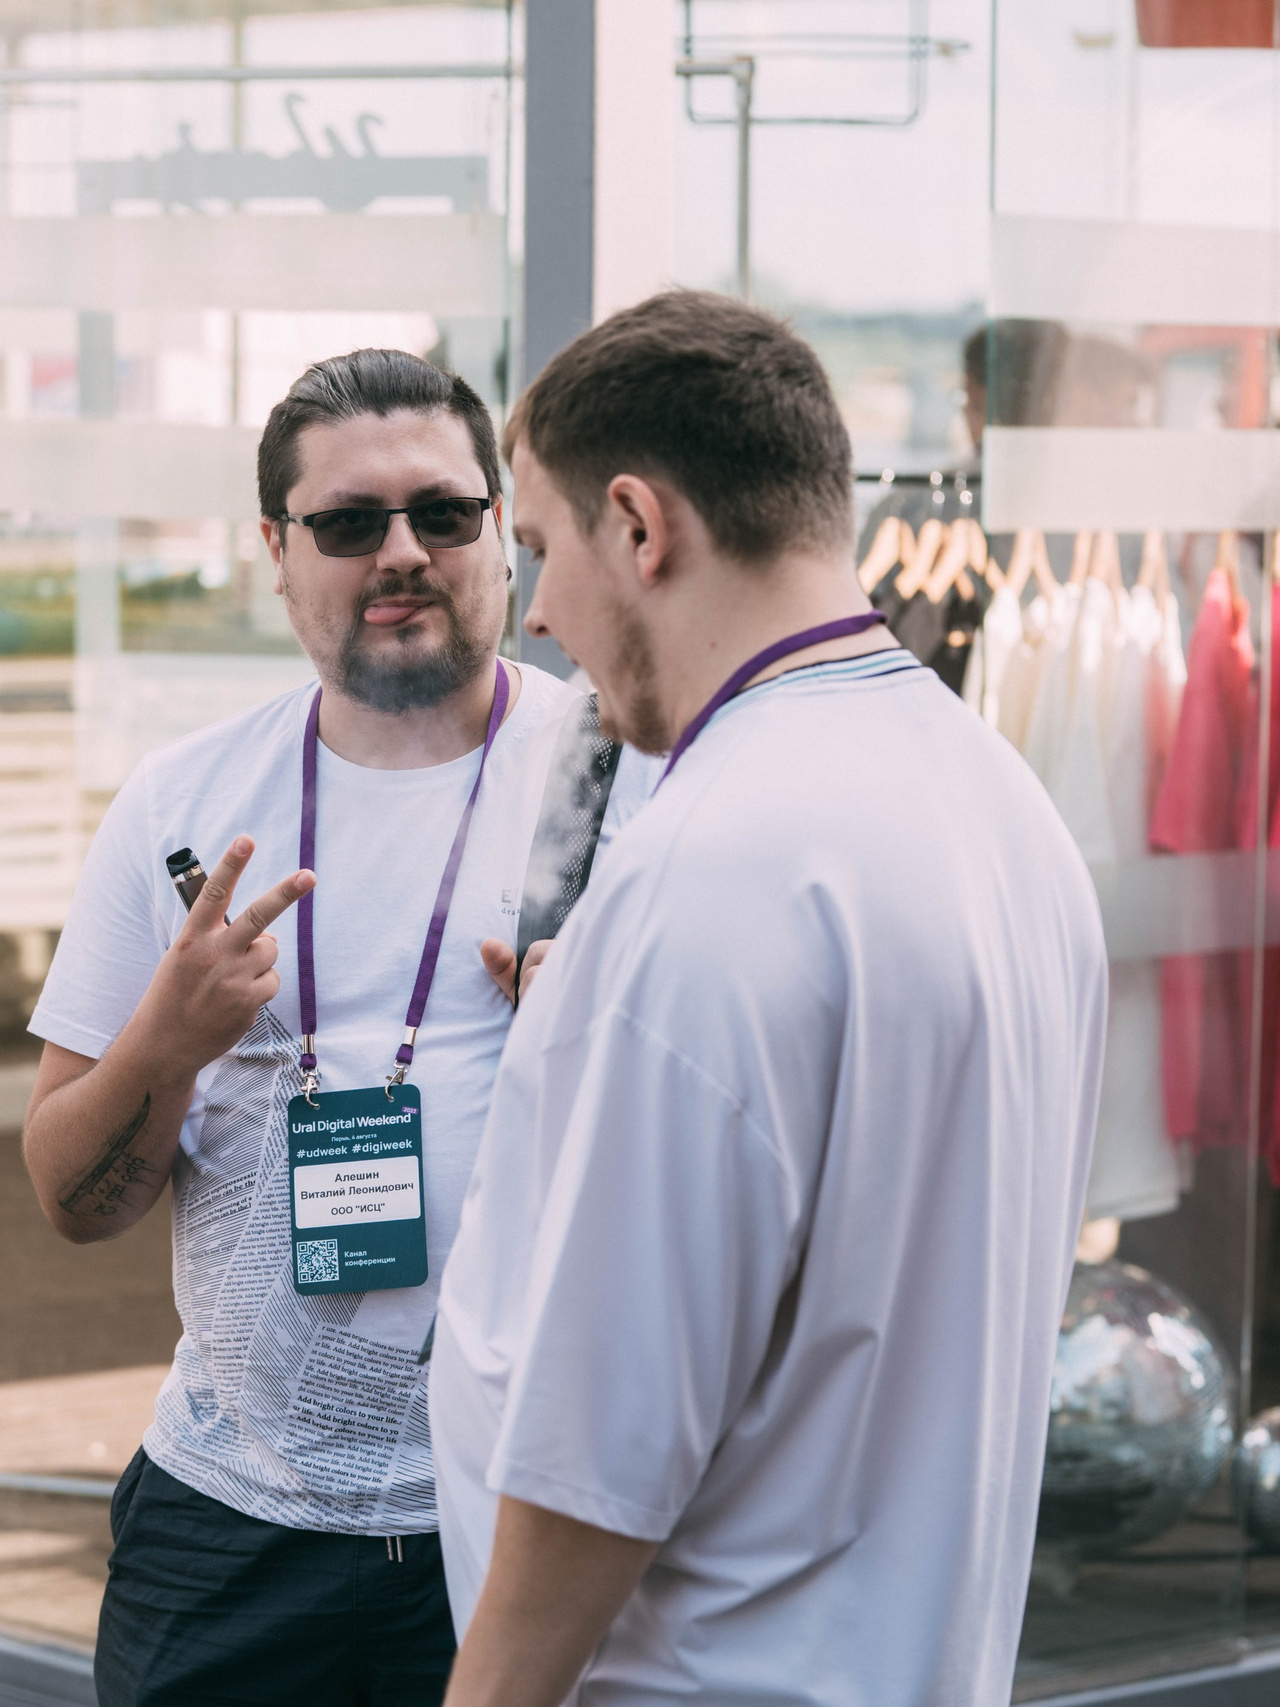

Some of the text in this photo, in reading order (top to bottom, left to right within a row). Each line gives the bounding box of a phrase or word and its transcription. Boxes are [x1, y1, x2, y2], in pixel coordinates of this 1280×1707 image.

[292, 1113, 411, 1134] Ural Digital Weekend
[296, 1139, 412, 1158] #udweek #digiweek
[335, 1172, 379, 1182] Алешин
[301, 1182, 414, 1200] Виталий Леонидович
[331, 1203, 385, 1215] ООО "ИСЦ"
[344, 1257, 396, 1267] конференции
[321, 1342, 331, 1350] life.
[332, 1346, 345, 1354] Add
[346, 1350, 363, 1359] bright
[364, 1356, 381, 1365] colors
[336, 1337, 346, 1345] life.
[348, 1342, 360, 1350] Add
[361, 1346, 378, 1356] bright
[379, 1352, 397, 1362] colors
[341, 1366, 358, 1376] bright
[358, 1372, 376, 1381] colors
[310, 1373, 327, 1382] colors
[348, 1382, 359, 1391] life.
[374, 1389, 391, 1398] bright
[297, 1395, 312, 1404] Add
[312, 1399, 334, 1411] bright
[335, 1406, 357, 1416] colors
[367, 1414, 384, 1422] your
[385, 1416, 399, 1425] life.
[302, 1407, 314, 1416] life.
[316, 1412, 331, 1421] Add
[332, 1416, 356, 1426] bright
[357, 1422, 379, 1431] colors
[296, 1416, 310, 1424] Add
[312, 1419, 333, 1431] bright
[367, 1433, 385, 1441] your
[312, 1463, 331, 1472] bright
[331, 1468, 349, 1476] colors
[350, 1481, 367, 1490] bright
